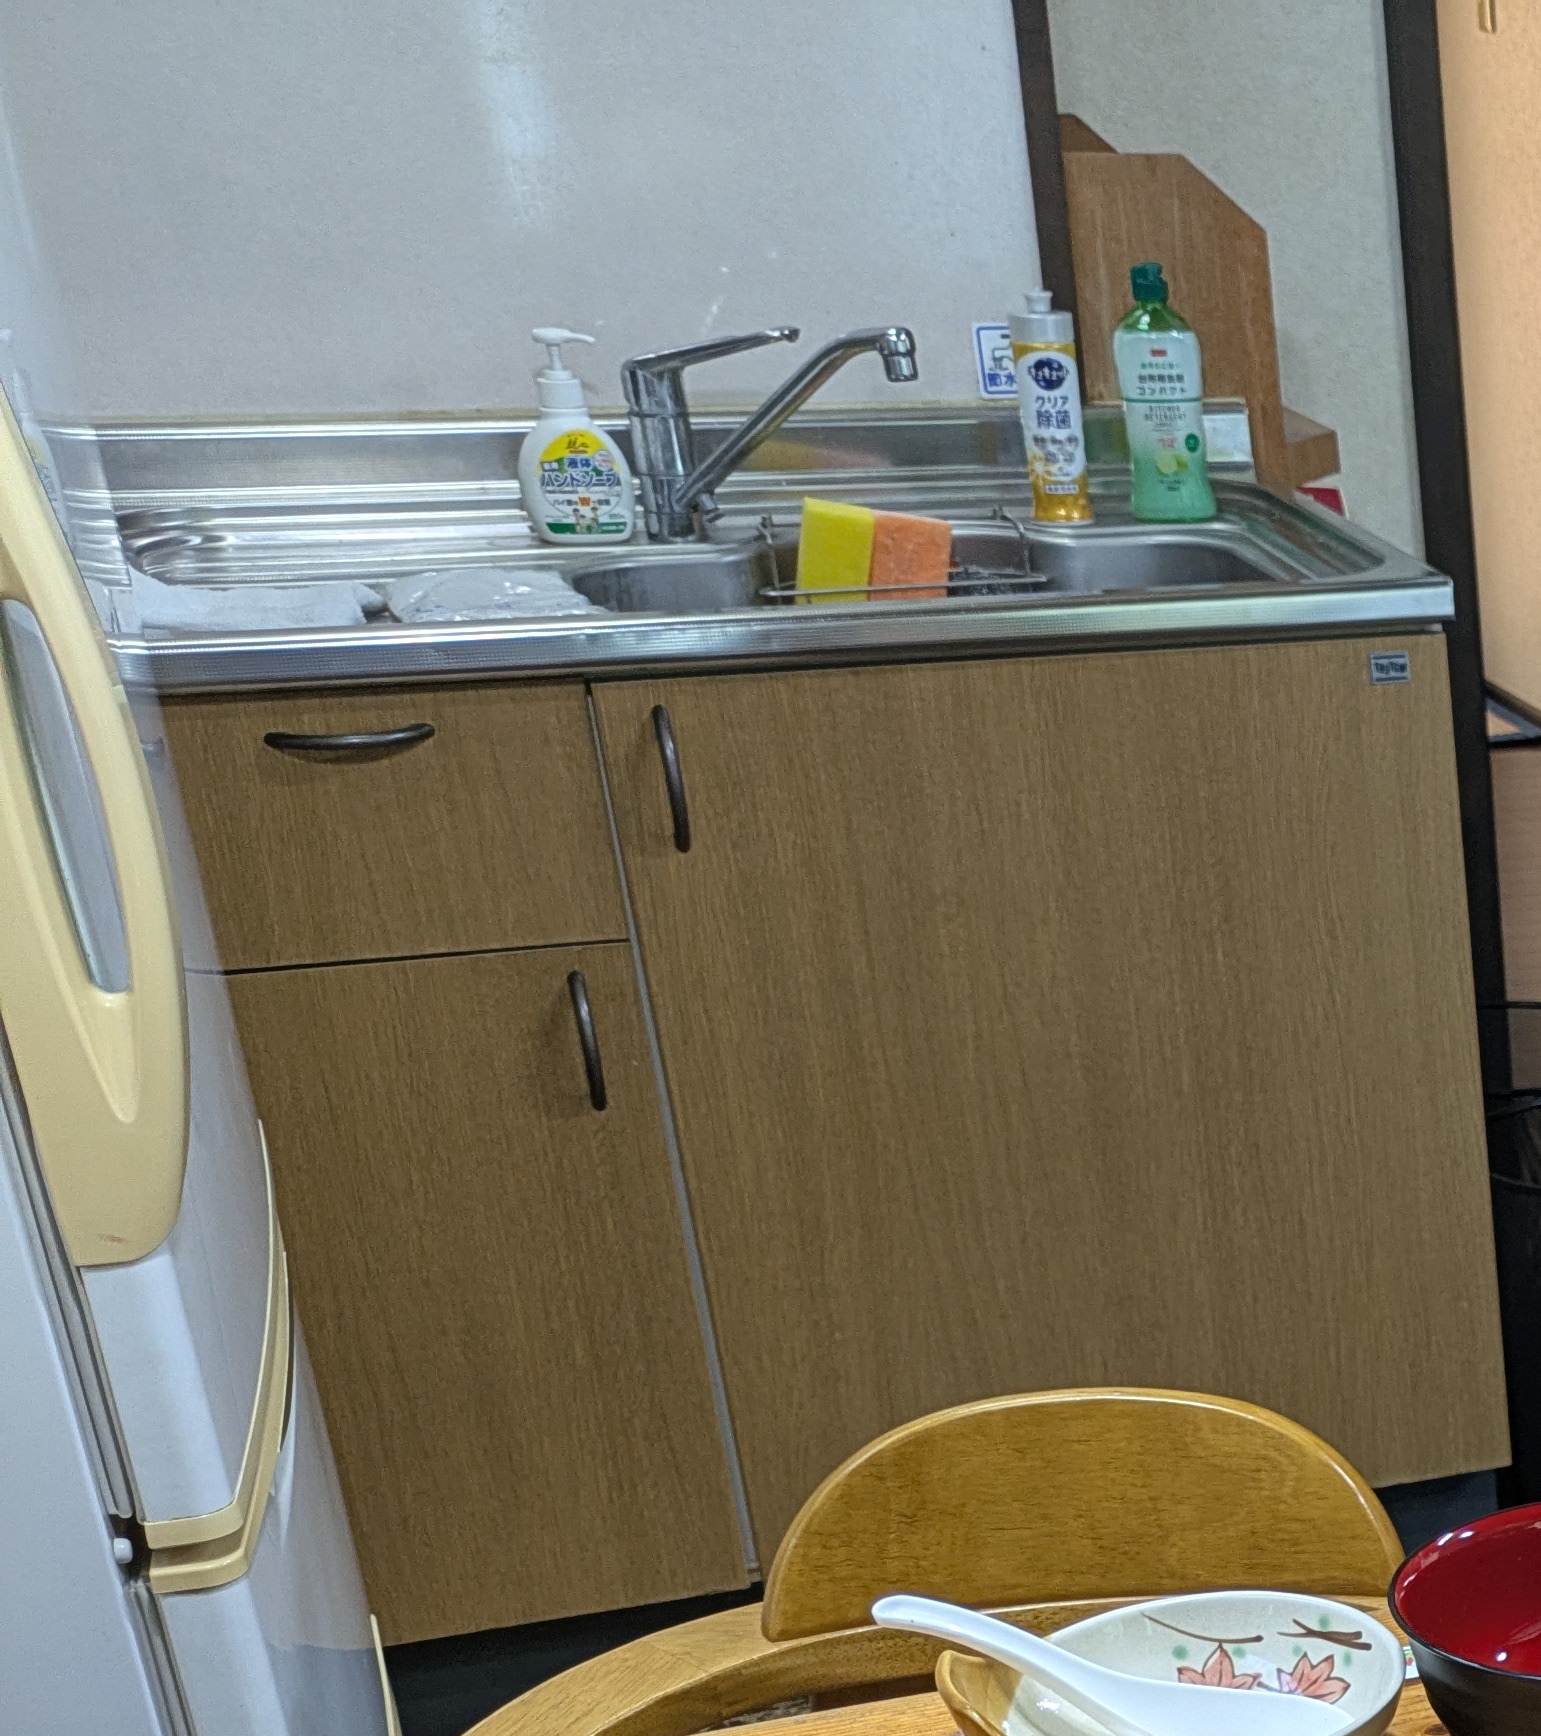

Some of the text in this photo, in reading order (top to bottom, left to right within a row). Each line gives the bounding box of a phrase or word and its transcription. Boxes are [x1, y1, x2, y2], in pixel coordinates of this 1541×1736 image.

[1036, 396, 1069, 409] クリア
[1036, 410, 1072, 429] 除菌
[540, 473, 618, 488] ハンドソープ
